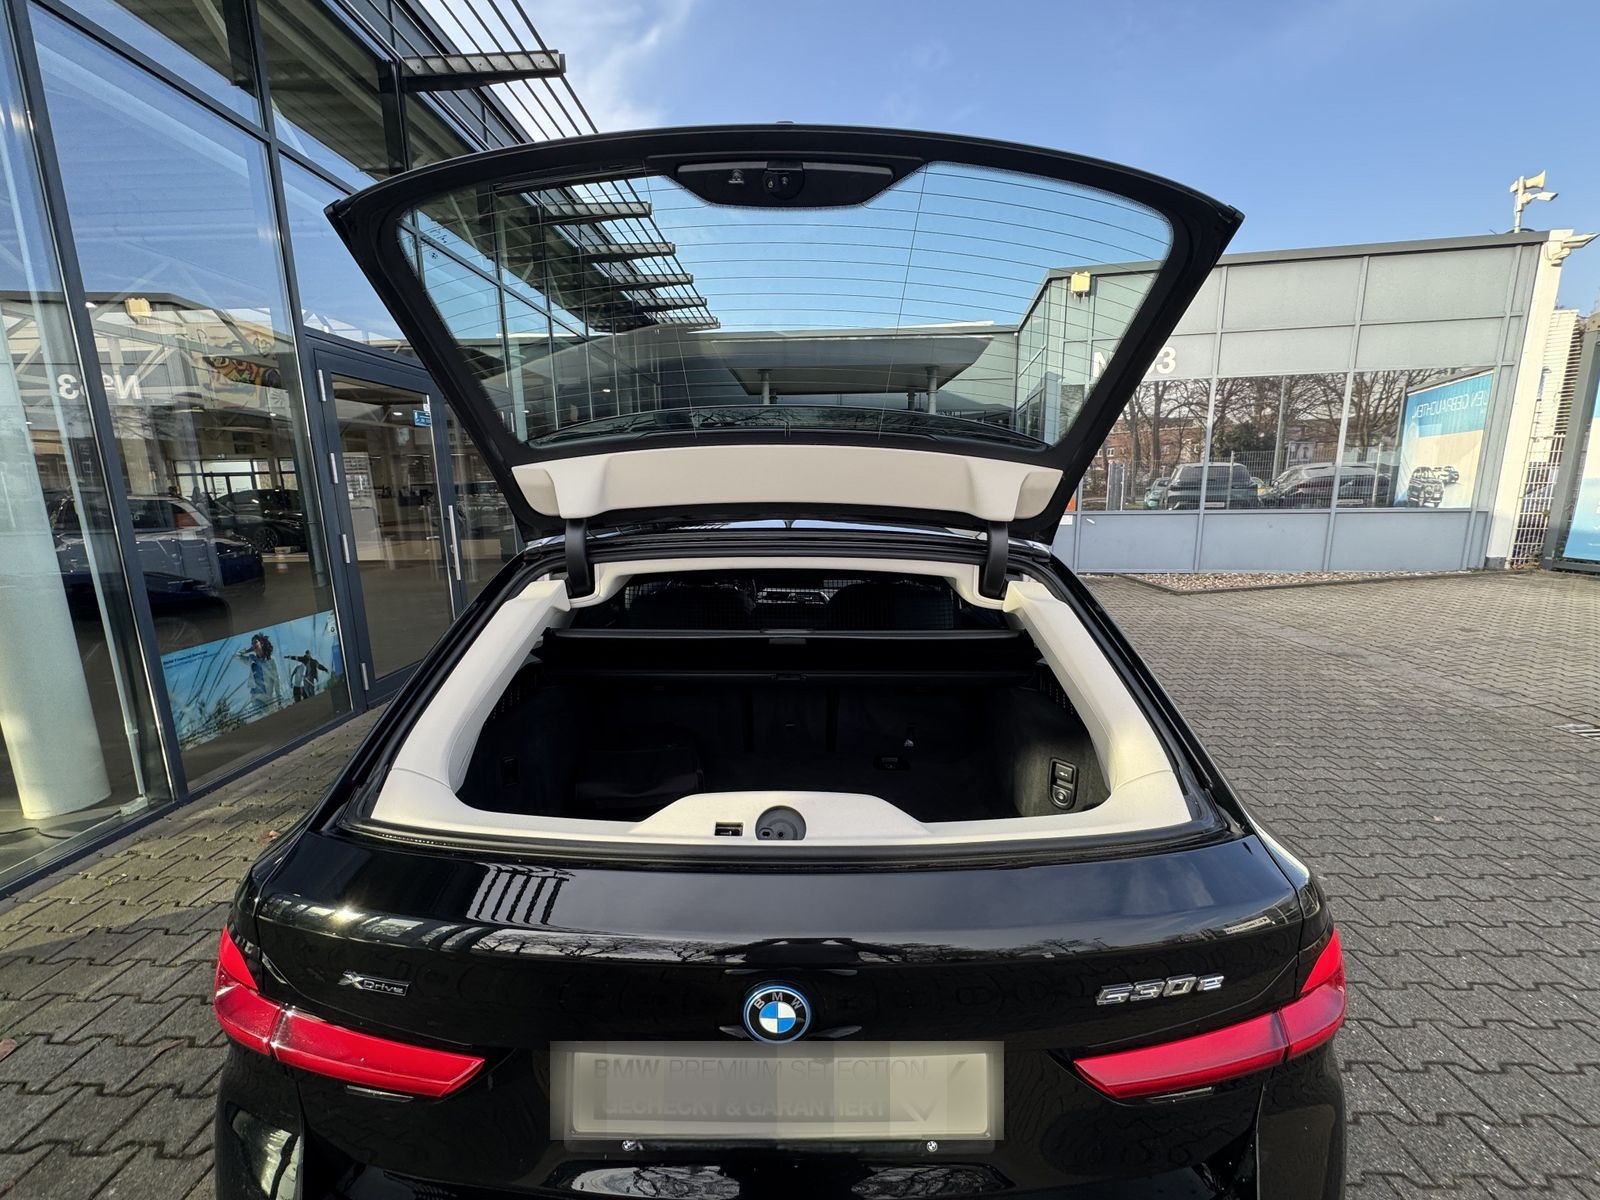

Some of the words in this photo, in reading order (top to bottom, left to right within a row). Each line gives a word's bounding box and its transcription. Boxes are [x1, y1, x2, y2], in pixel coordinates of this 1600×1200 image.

[753, 992, 803, 1010] BMW
[593, 1058, 661, 1080] BMW
[668, 1059, 782, 1081] PREMIUM
[725, 1097, 742, 1116] &
